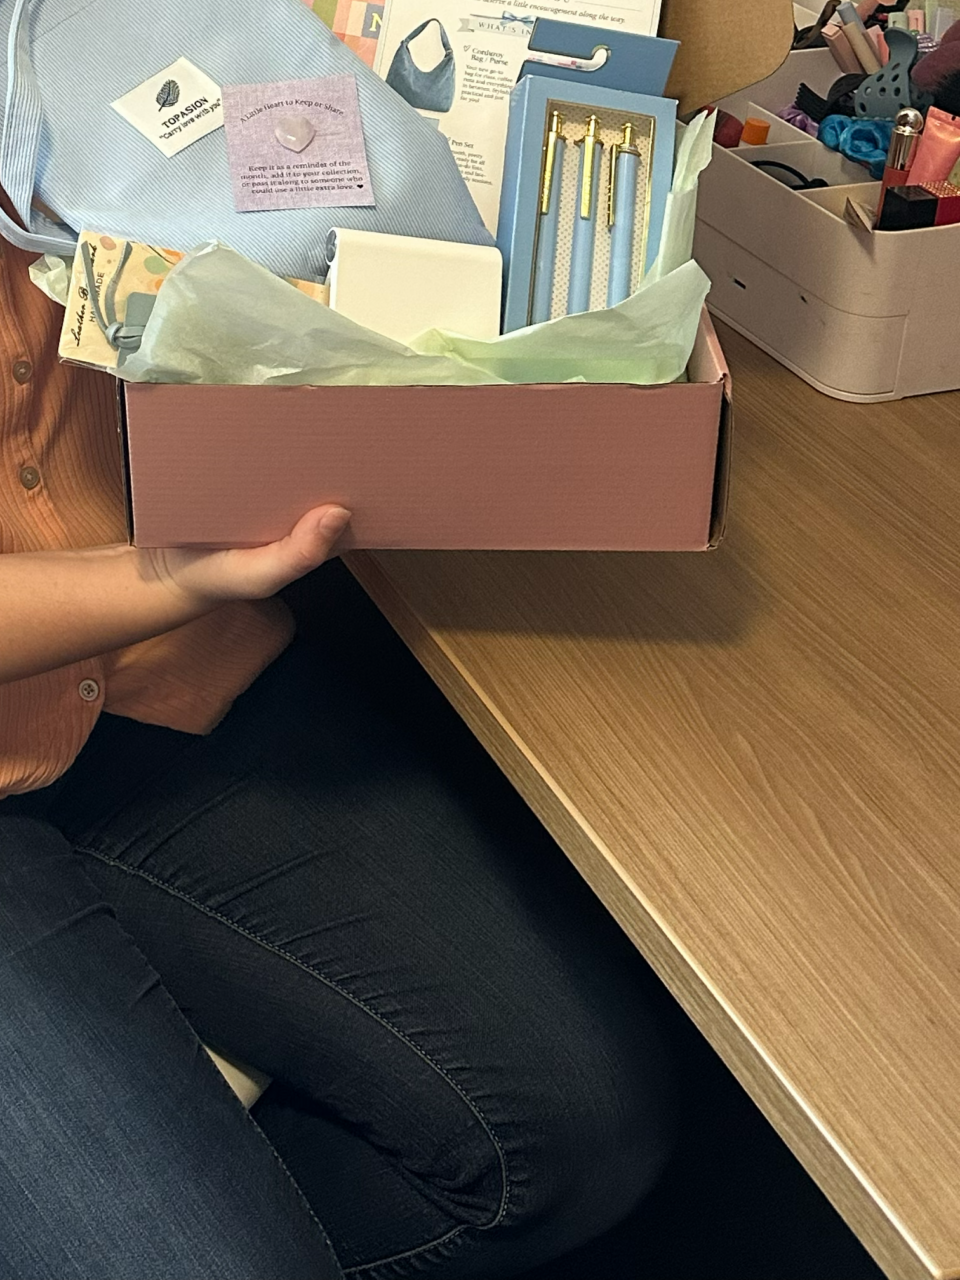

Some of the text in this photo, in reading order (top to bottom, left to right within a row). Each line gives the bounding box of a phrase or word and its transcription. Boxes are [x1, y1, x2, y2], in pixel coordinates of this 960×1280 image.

[529, 3, 578, 16] encouragement
[579, 9, 599, 20] along
[599, 12, 610, 21] the
[478, 22, 516, 33] WHAT'S
[472, 47, 504, 59] Corduroy
[161, 96, 209, 128] TOPASION
[194, 108, 211, 120] with
[244, 108, 263, 121] Little
[263, 101, 285, 111] Heart
[295, 99, 313, 108] Keep
[324, 104, 344, 116] Share
[292, 162, 327, 170] reminder
[277, 179, 300, 187] along
[89, 272, 105, 322] HAMADE
